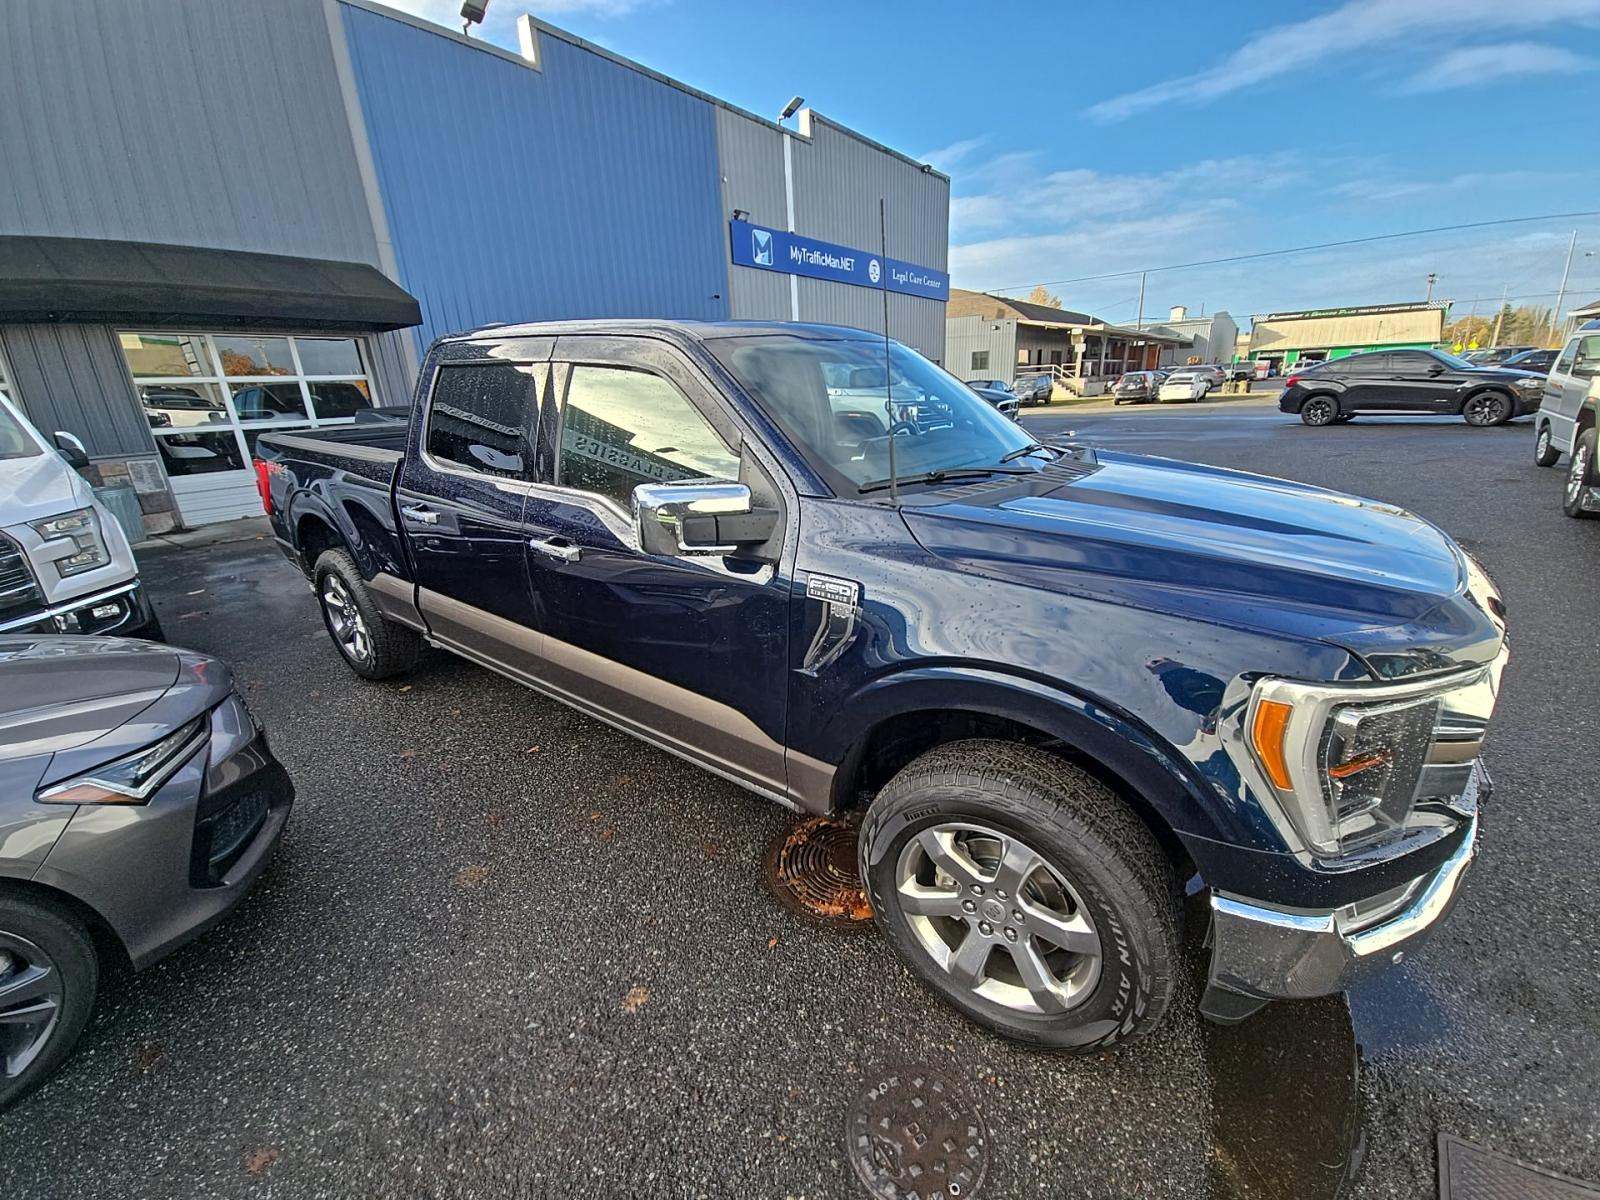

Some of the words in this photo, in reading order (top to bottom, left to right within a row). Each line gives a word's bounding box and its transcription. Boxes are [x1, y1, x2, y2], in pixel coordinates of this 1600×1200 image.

[790, 245, 855, 272] MyTrafficMan.NET
[892, 268, 908, 284] Legal
[909, 272, 922, 285] Care
[923, 275, 941, 288] Center
[902, 803, 940, 822] PIRELLI
